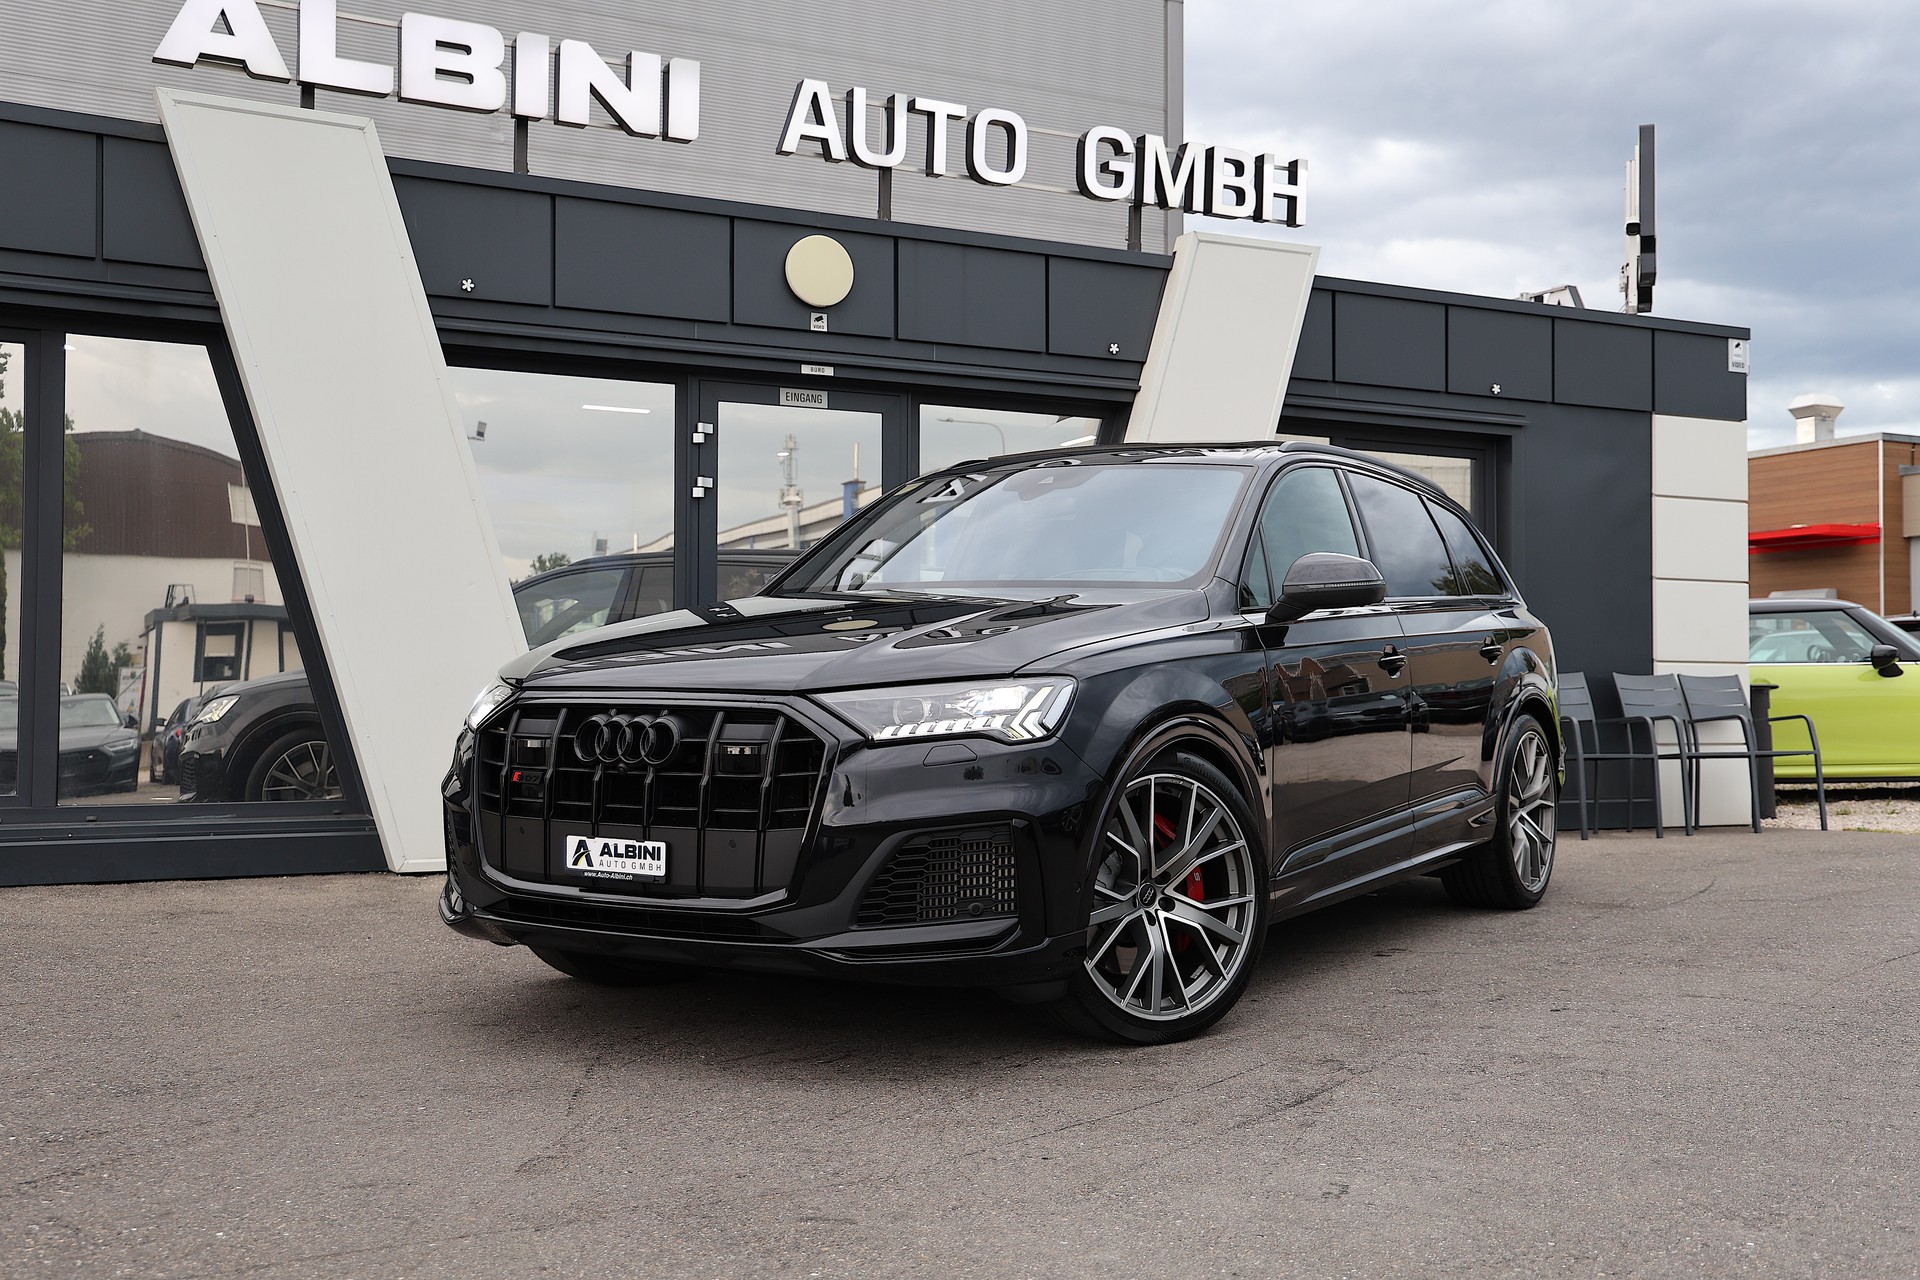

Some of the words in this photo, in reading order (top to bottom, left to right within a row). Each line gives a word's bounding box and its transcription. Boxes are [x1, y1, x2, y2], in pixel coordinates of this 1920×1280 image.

[152, 0, 700, 143] ALBINI
[776, 78, 1028, 186] AUTO
[1076, 125, 1309, 228] GMBH
[785, 392, 823, 404] EINGANG
[599, 843, 661, 861] ALBINI
[599, 860, 626, 869] AUTO
[631, 862, 661, 871] GMBH
[584, 872, 633, 880] www.Auto-Albini.ch
